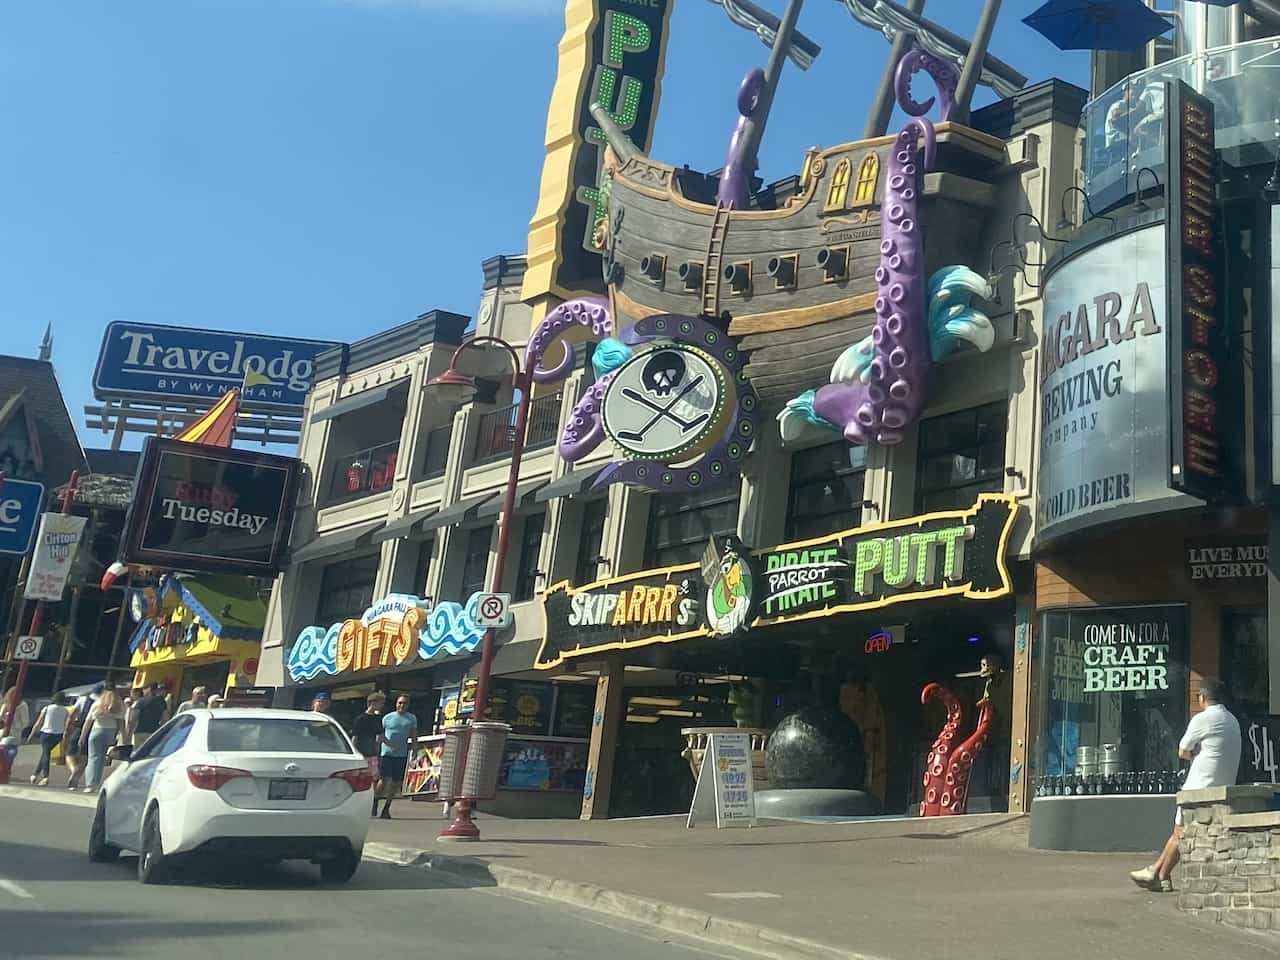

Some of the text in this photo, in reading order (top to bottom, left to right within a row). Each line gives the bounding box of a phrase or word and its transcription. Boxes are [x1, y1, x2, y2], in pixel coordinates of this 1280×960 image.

[121, 330, 313, 392] Travelodg
[158, 379, 179, 389] BY
[1079, 472, 1131, 510] BEER
[162, 498, 269, 535] Tuesday
[854, 526, 972, 596] PUTT
[1189, 547, 1232, 563] LIVE
[768, 567, 829, 593] PARROT
[336, 607, 421, 672] GIFTS
[865, 637, 889, 653] OPEN
[1084, 621, 1170, 645] COME IN FOR A
[1084, 644, 1169, 666] CRAFT
[1083, 665, 1169, 692] BEER
